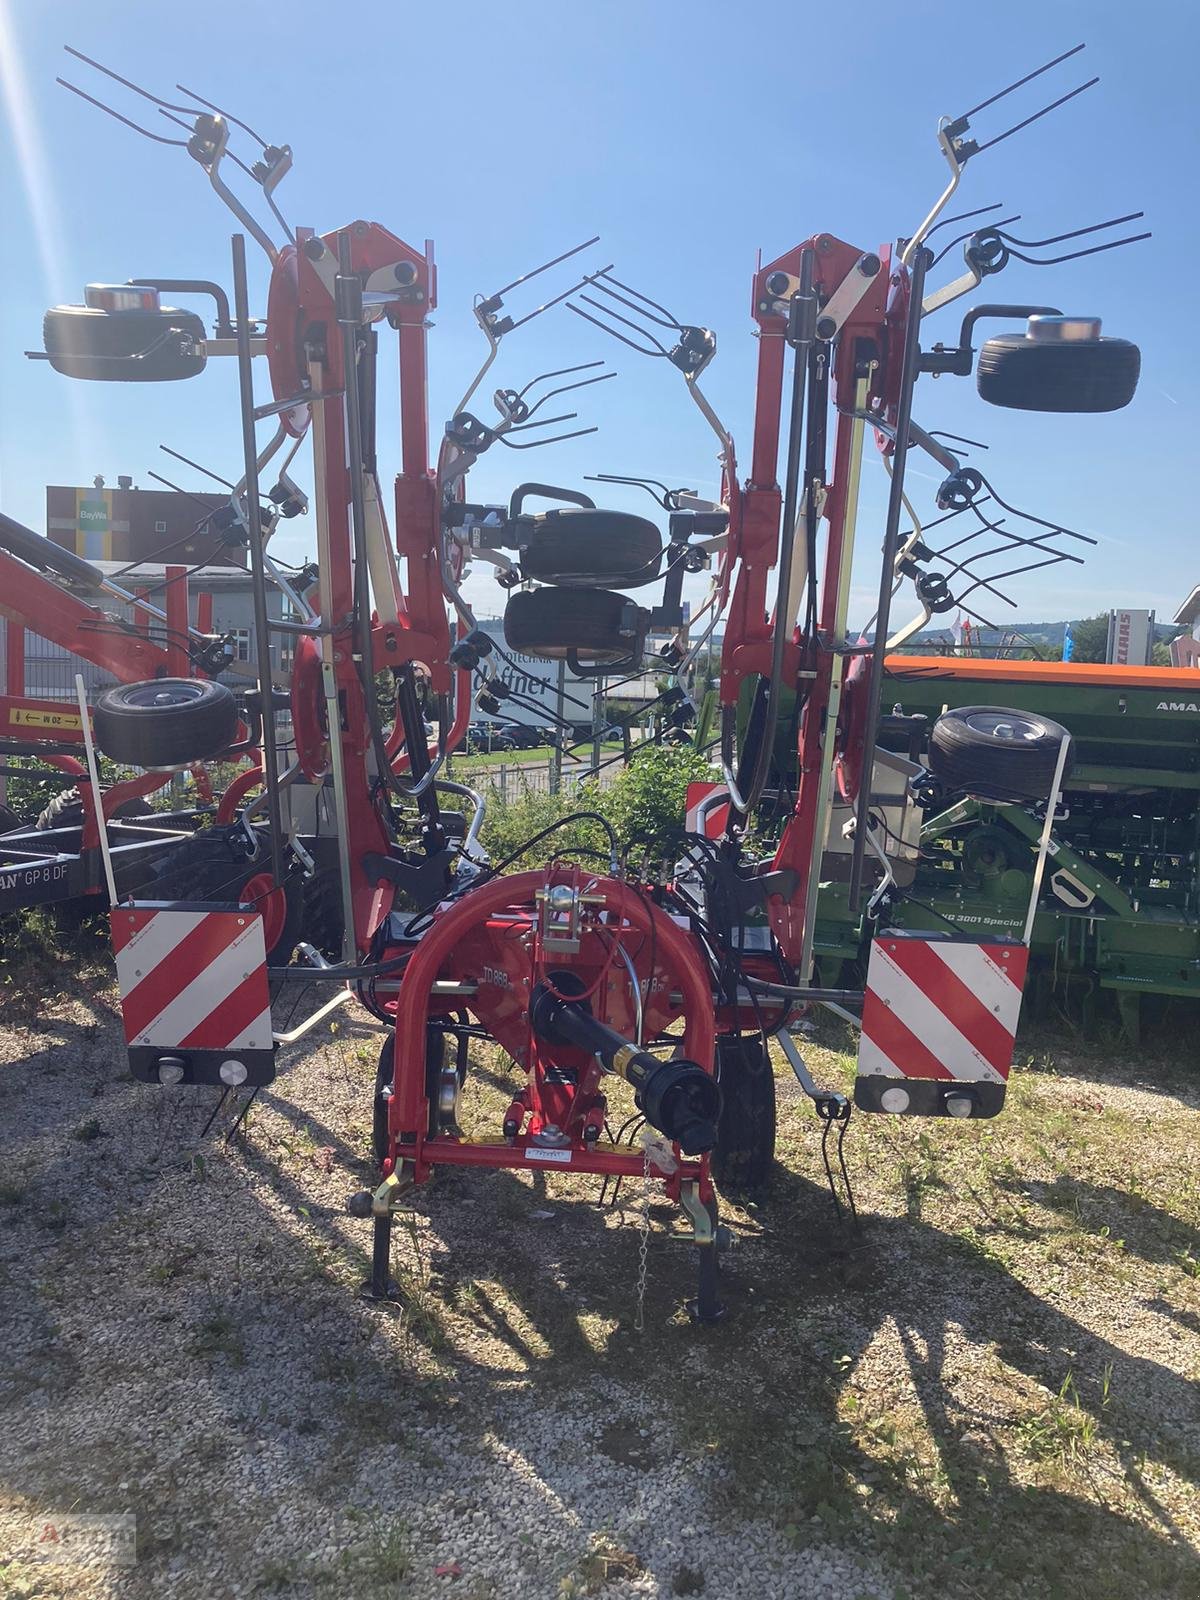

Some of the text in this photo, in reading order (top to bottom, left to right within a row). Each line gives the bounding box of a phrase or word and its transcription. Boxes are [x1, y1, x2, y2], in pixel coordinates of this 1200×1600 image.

[80, 510, 107, 521] BayWa
[1117, 613, 1131, 664] CLAAS
[473, 664, 551, 695] dffner
[1156, 702, 1200, 713] AMA
[25, 869, 41, 885] GP
[43, 867, 51, 882] 8
[53, 864, 68, 880] DF
[957, 914, 982, 924] 3001
[983, 917, 1024, 927] Special
